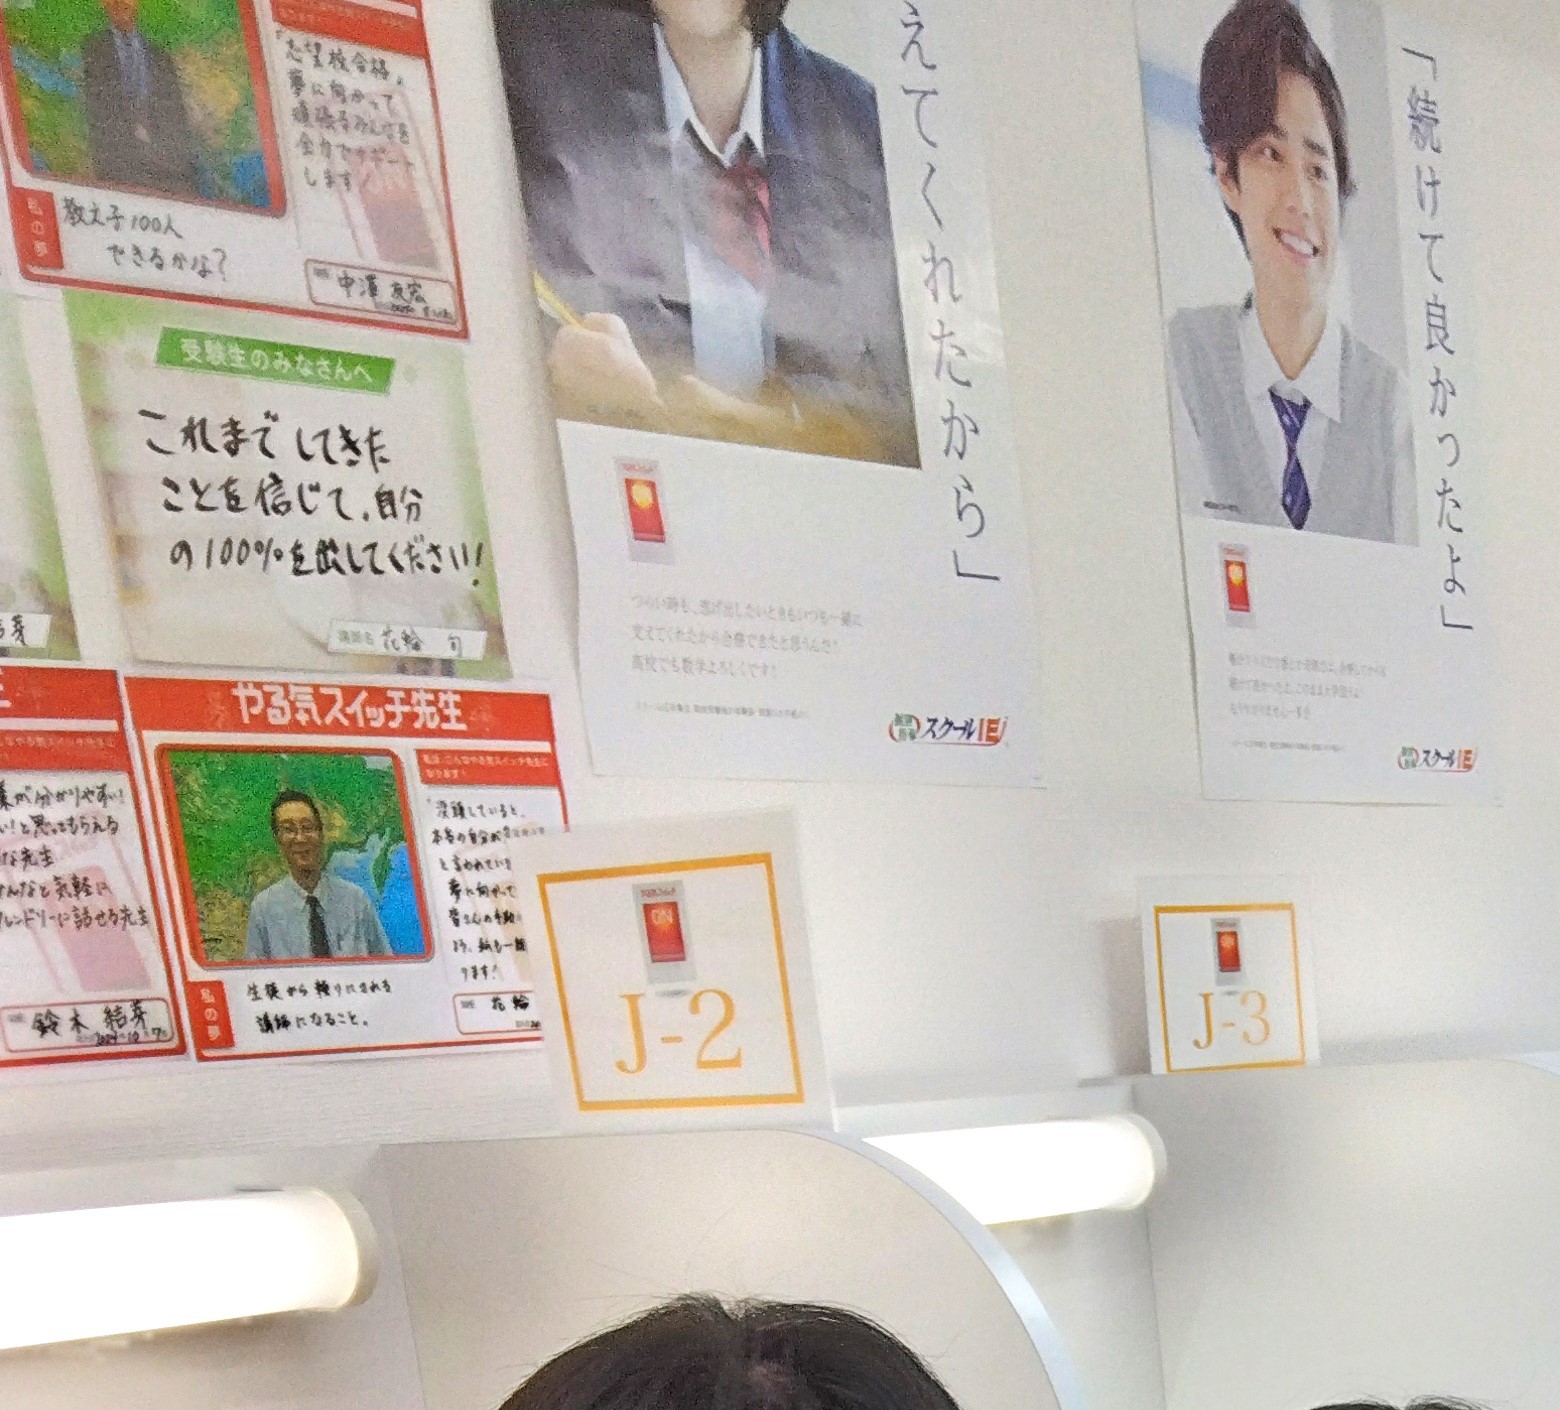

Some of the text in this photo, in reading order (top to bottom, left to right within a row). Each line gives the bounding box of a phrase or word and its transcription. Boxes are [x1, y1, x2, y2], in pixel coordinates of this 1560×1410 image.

[64, 197, 183, 239] 教え子100人
[181, 337, 373, 383] 受験生のみなさんへ
[1402, 47, 1473, 630] 「続けて良かったよ」
[232, 682, 467, 731] やる気スイッチ先生
[0, 873, 112, 901] んなと気軽に
[0, 905, 149, 931] レンドリーに話せる先生
[615, 988, 743, 1075] J-2
[1193, 990, 1271, 1049] J-3
